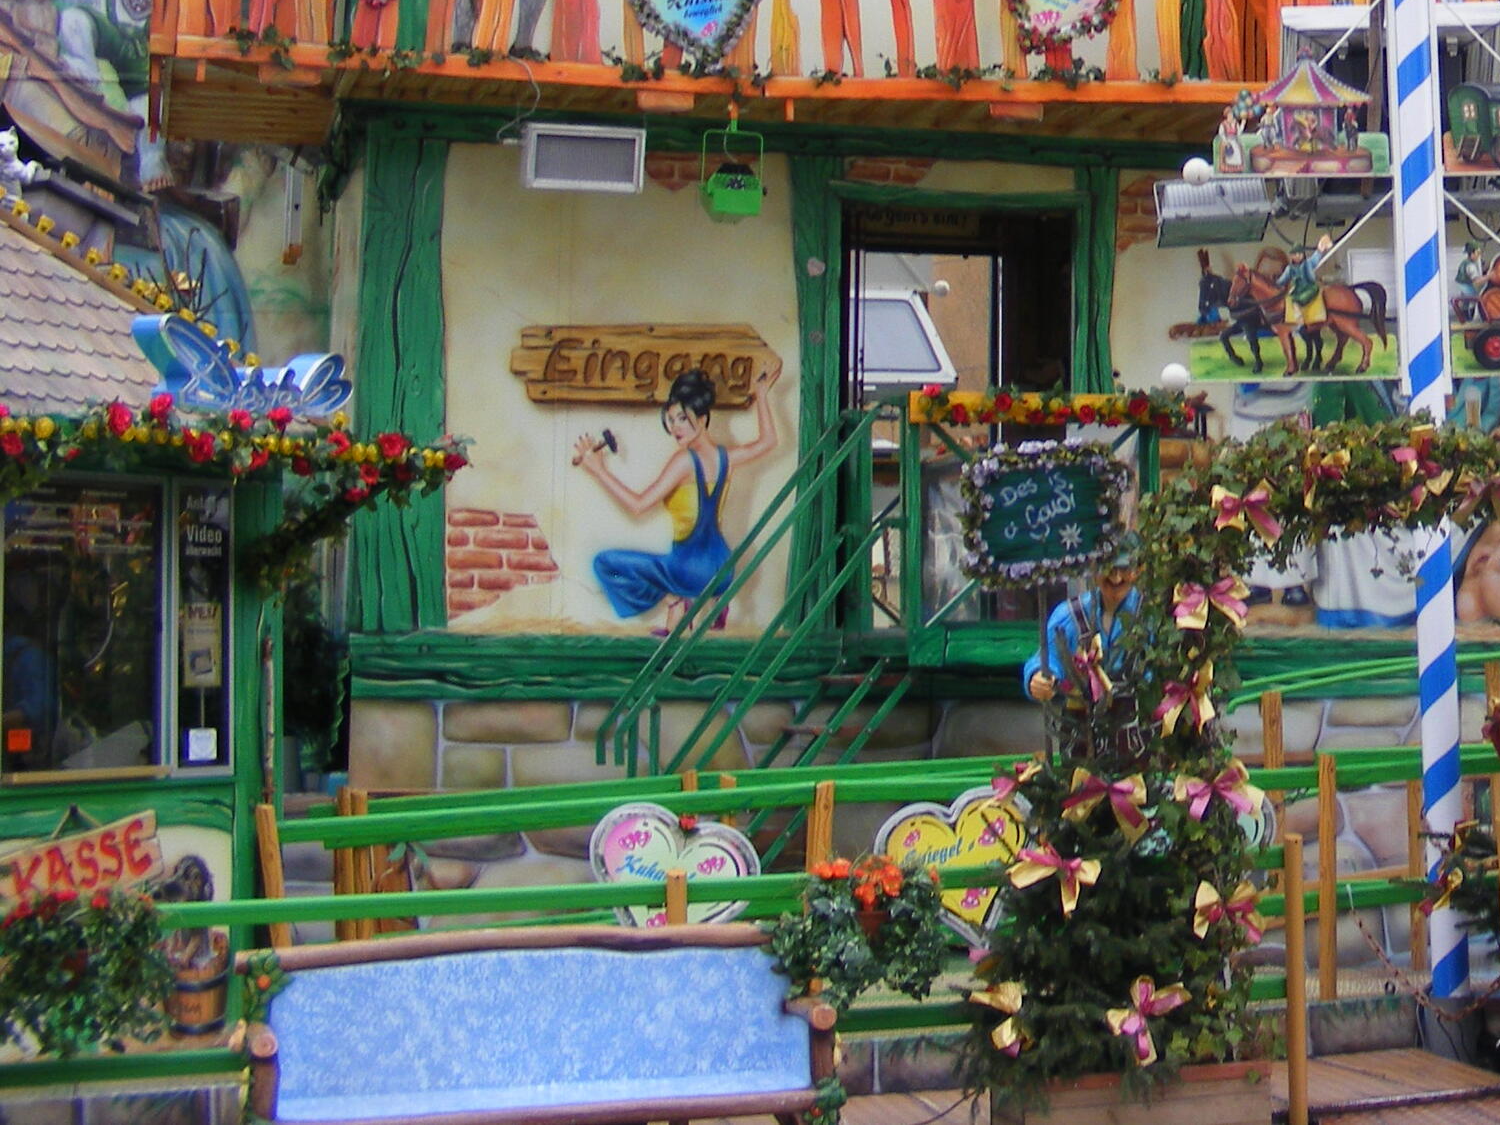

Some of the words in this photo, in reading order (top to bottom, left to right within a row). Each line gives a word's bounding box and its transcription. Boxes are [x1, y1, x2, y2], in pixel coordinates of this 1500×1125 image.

[543, 338, 753, 395] Eingang
[187, 524, 222, 544] Video
[11, 817, 153, 894] KASSE
